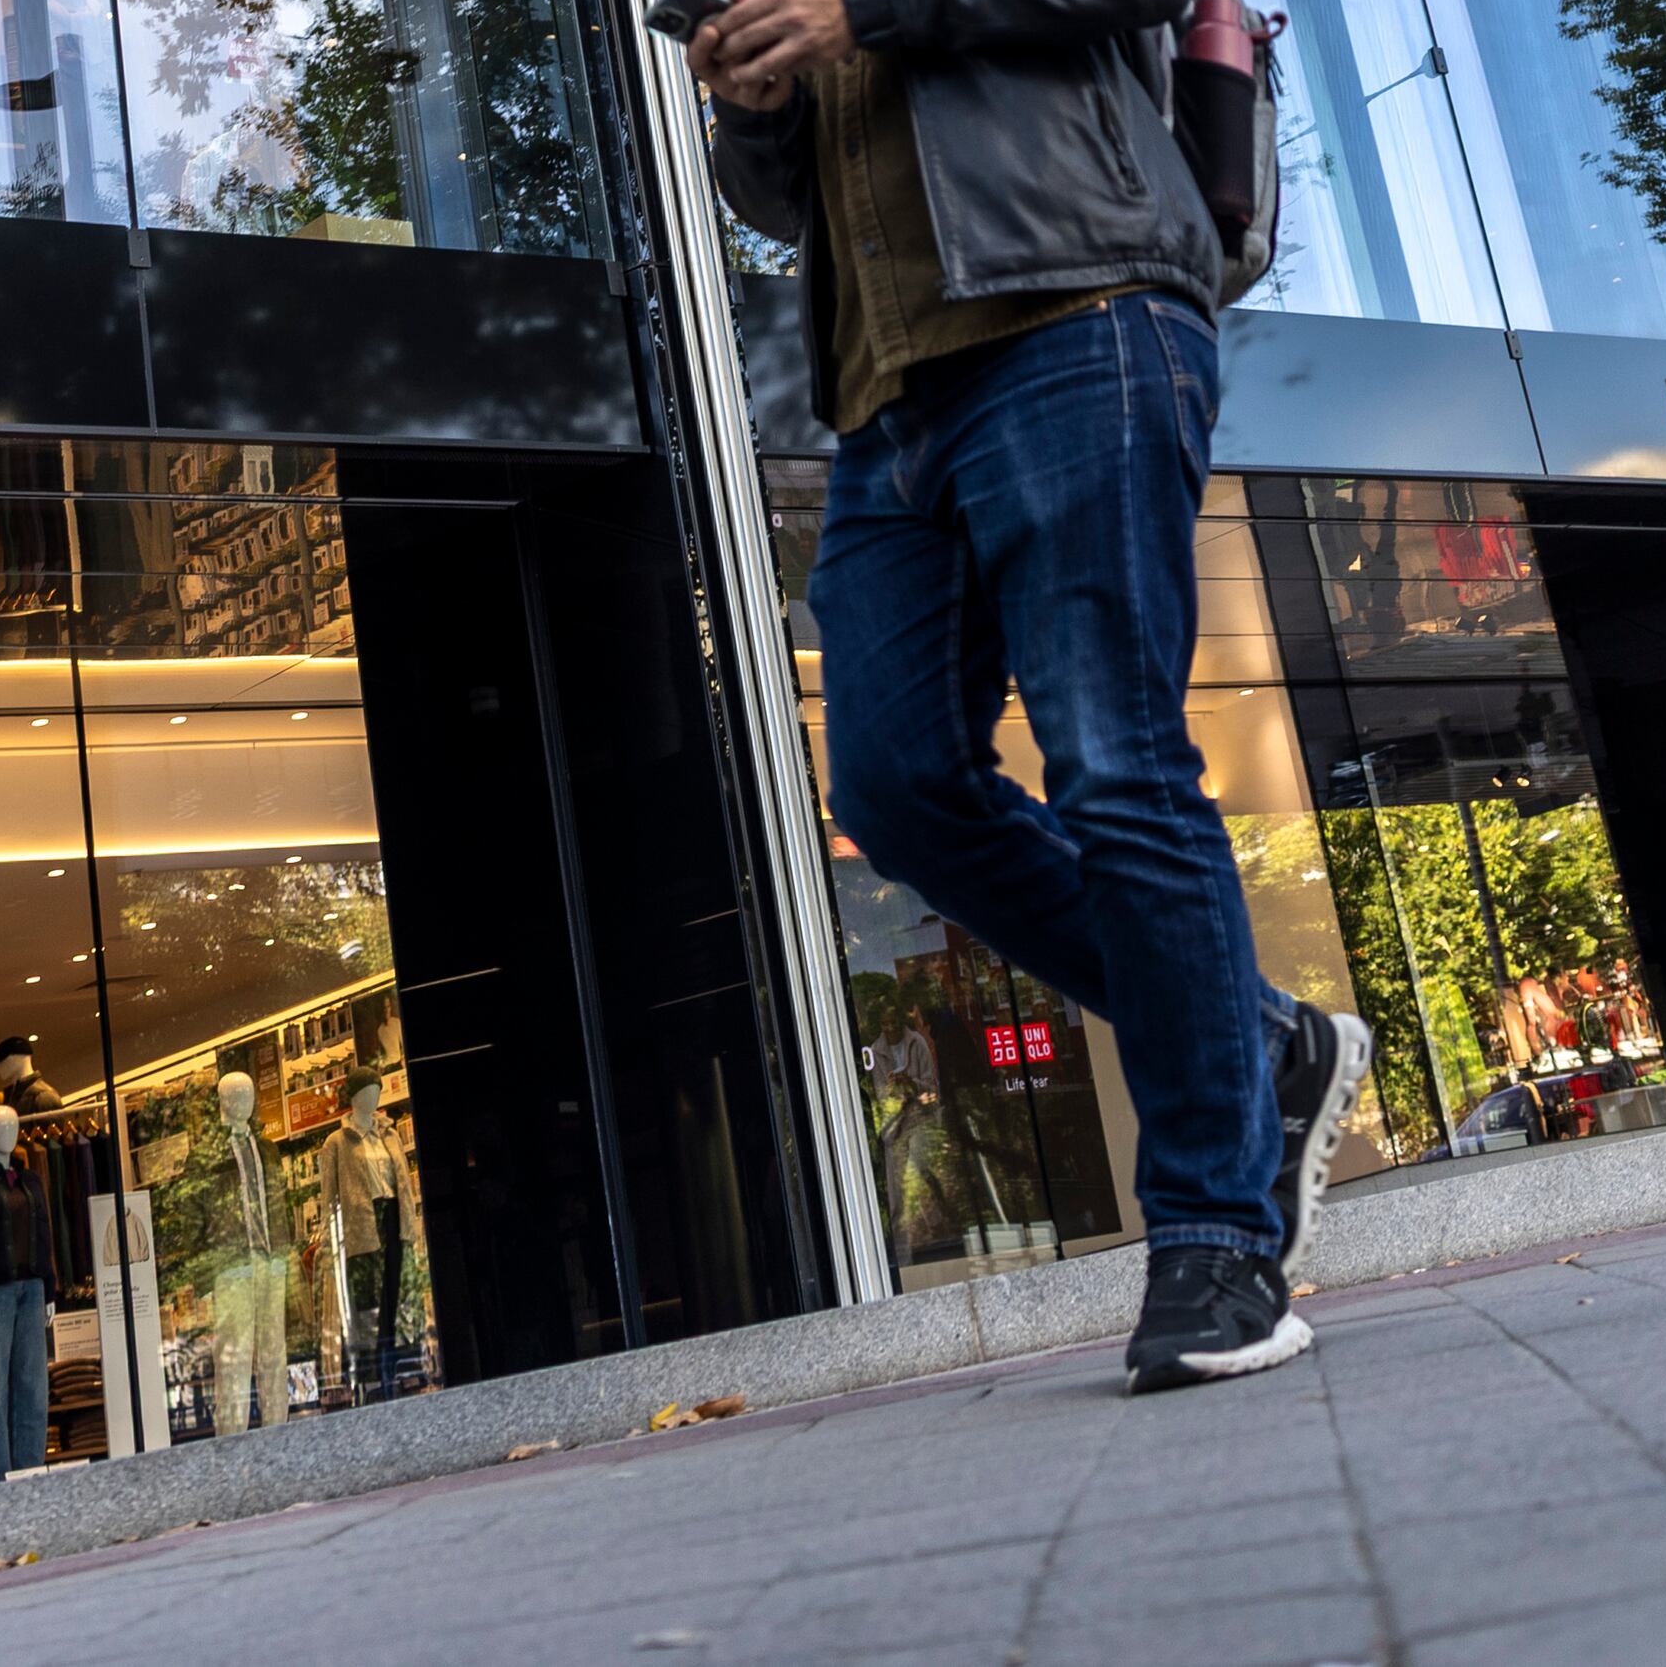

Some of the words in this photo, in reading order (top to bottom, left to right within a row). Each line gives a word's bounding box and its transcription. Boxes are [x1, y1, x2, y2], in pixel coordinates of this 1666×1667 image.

[1024, 1027, 1046, 1042] UNI
[1027, 1042, 1051, 1060] QLO
[1005, 1076, 1049, 1092] Lifeear
